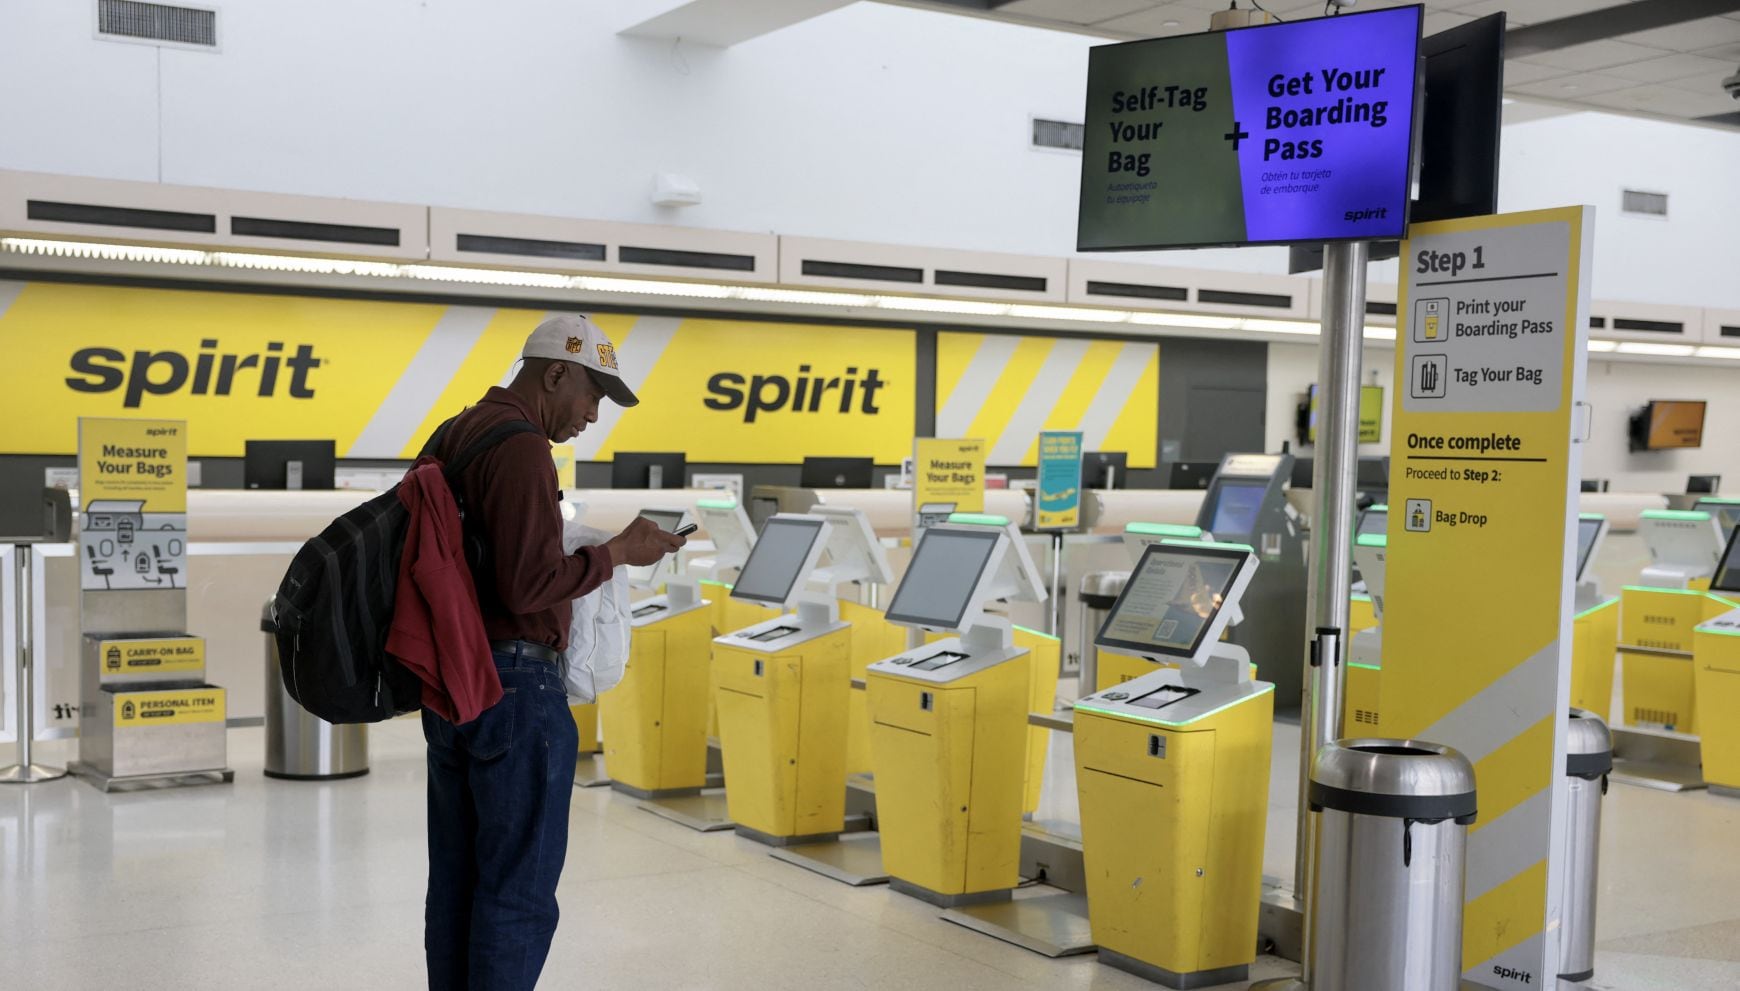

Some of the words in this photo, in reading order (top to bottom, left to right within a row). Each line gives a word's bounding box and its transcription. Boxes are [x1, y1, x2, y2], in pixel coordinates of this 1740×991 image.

[1268, 72, 1313, 97] Get
[1322, 68, 1385, 92] Your
[1111, 85, 1207, 113] Self-Tag
[1266, 97, 1388, 129] Boarding
[1109, 121, 1163, 142] Your
[1264, 139, 1322, 161] Pass
[1108, 151, 1151, 177] Bag
[1289, 171, 1300, 181] tu
[1301, 168, 1333, 182] tarjeta
[1259, 184, 1272, 195] de
[1272, 182, 1321, 195] embarque
[1344, 208, 1387, 222] spirit
[1416, 250, 1465, 276] Step
[1472, 246, 1484, 269] 1
[1457, 299, 1490, 315] Print
[1494, 300, 1526, 316] your
[1456, 320, 1518, 339] Boarding
[1522, 320, 1552, 334] Pass
[65, 339, 321, 408] spirit
[1454, 369, 1478, 386] Tag
[1481, 368, 1512, 381] Your
[1516, 367, 1542, 385] Bag
[703, 365, 884, 423] spirit
[145, 428, 178, 437] spirit
[103, 445, 167, 458] Measure
[1408, 433, 1444, 449] Once
[1448, 433, 1520, 453] complete
[97, 461, 132, 474] Your
[137, 462, 172, 478] Bags
[930, 459, 973, 471] Measure
[926, 472, 950, 483] Your
[951, 472, 976, 486] Bags
[1406, 467, 1447, 480] Proceed
[1449, 468, 1461, 481] to
[1464, 469, 1488, 483] Step
[1490, 469, 1502, 482] 2:
[1436, 511, 1456, 526] Bag
[1460, 512, 1487, 527] Drop
[126, 647, 174, 658] CARRY-ON
[175, 646, 195, 656] BAG
[140, 699, 190, 710] PERSONAL
[192, 697, 215, 706] ITEM
[1493, 964, 1532, 984] spirit
